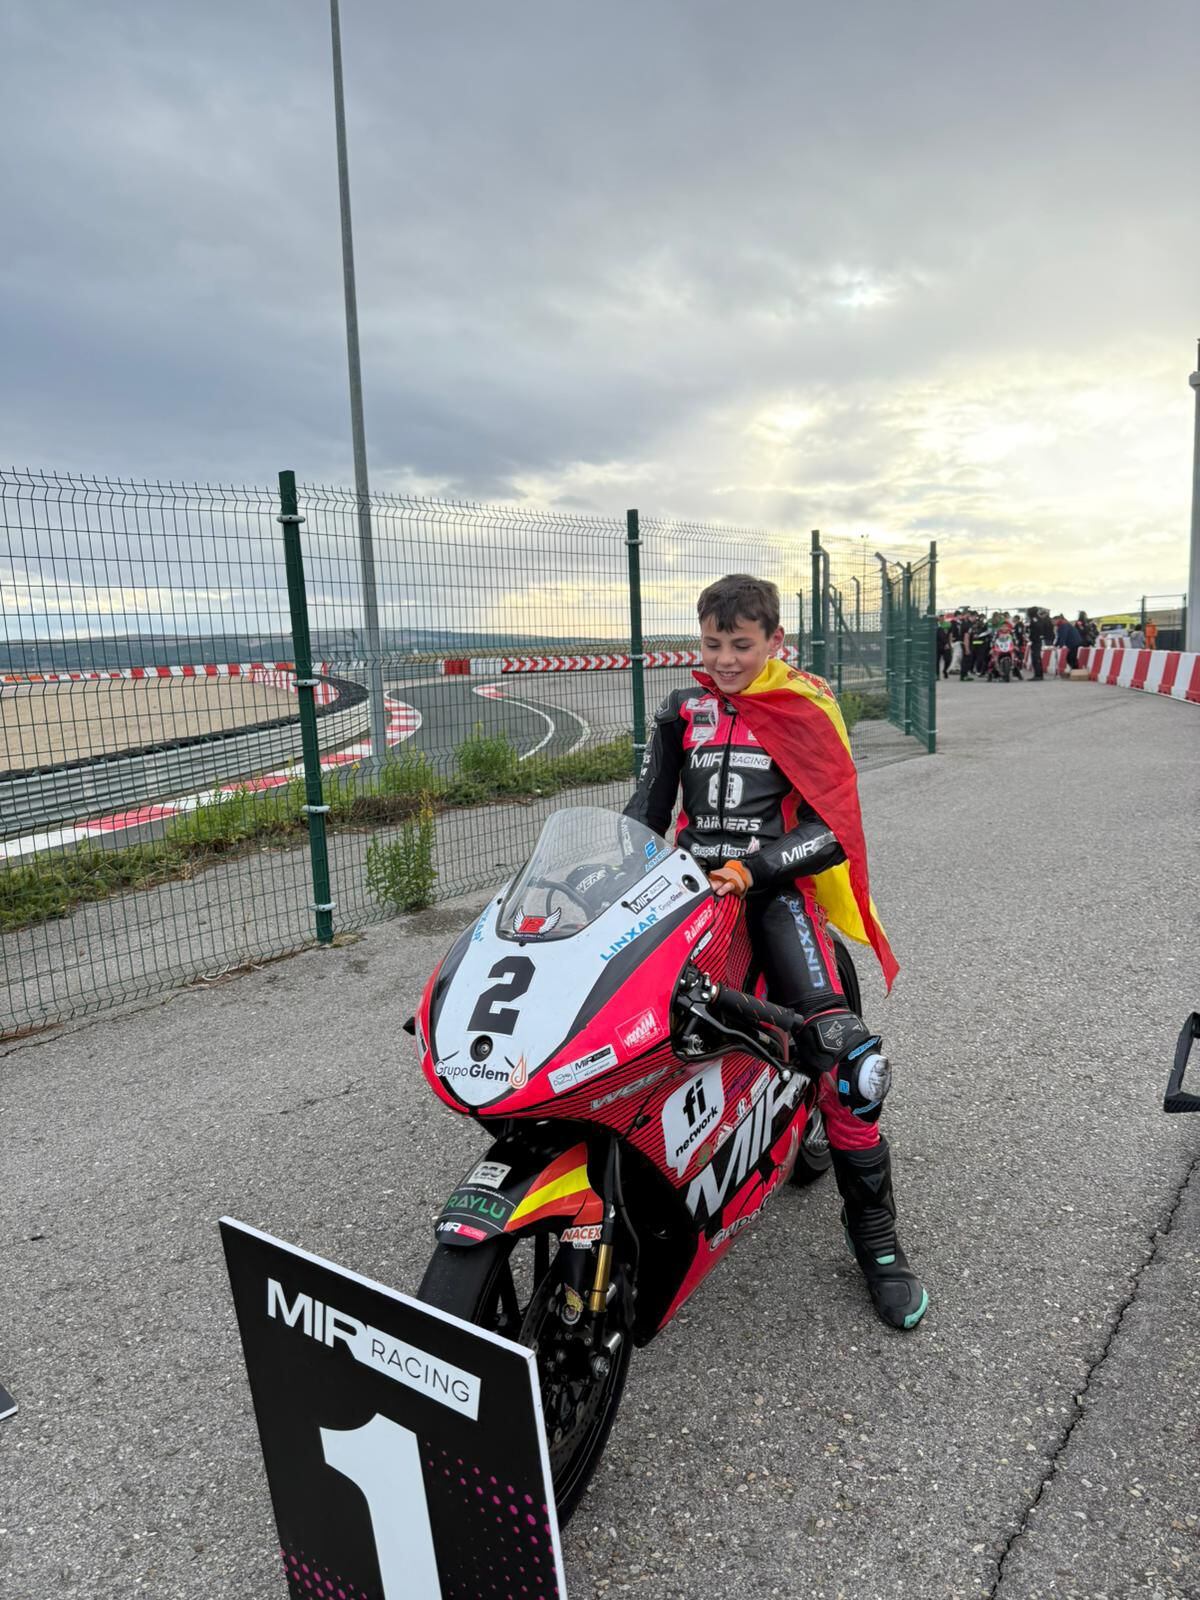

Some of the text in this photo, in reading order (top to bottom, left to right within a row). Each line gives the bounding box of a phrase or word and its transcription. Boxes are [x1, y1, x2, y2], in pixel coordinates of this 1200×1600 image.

[781, 841, 815, 866] MIR
[630, 892, 652, 913] MIR
[467, 956, 536, 1036] 2
[683, 1078, 707, 1128] fi
[675, 1106, 719, 1157] network
[448, 1194, 506, 1220] RAYLU
[436, 1221, 462, 1233] MIR
[561, 1226, 602, 1240] NACEX
[267, 1277, 470, 1403] MIR RACING
[319, 1412, 443, 1600] 1
